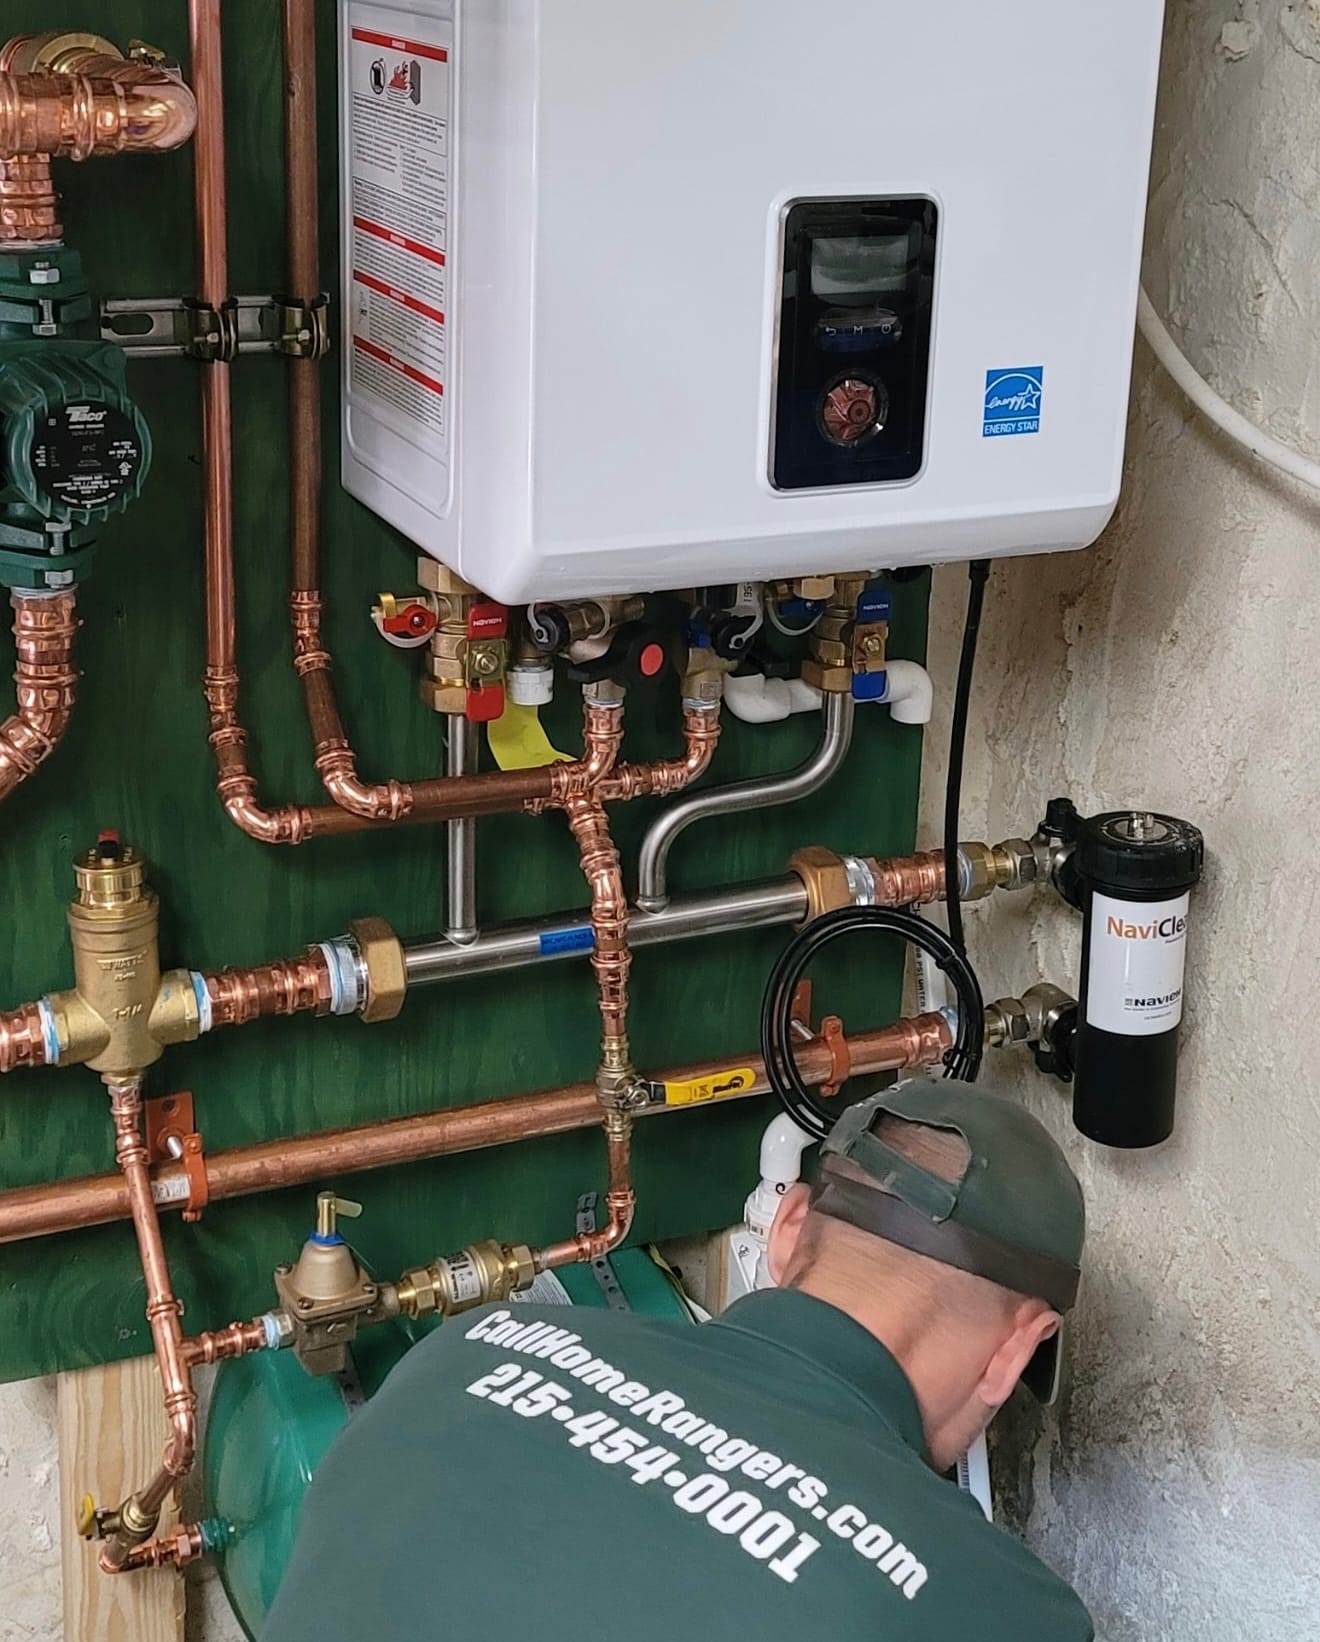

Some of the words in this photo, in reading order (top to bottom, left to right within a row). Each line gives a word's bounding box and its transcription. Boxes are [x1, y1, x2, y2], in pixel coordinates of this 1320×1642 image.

[984, 422, 1016, 434] ENERGY
[1017, 420, 1038, 432] STAR
[464, 1310, 928, 1600] CallHomeRangers.com
